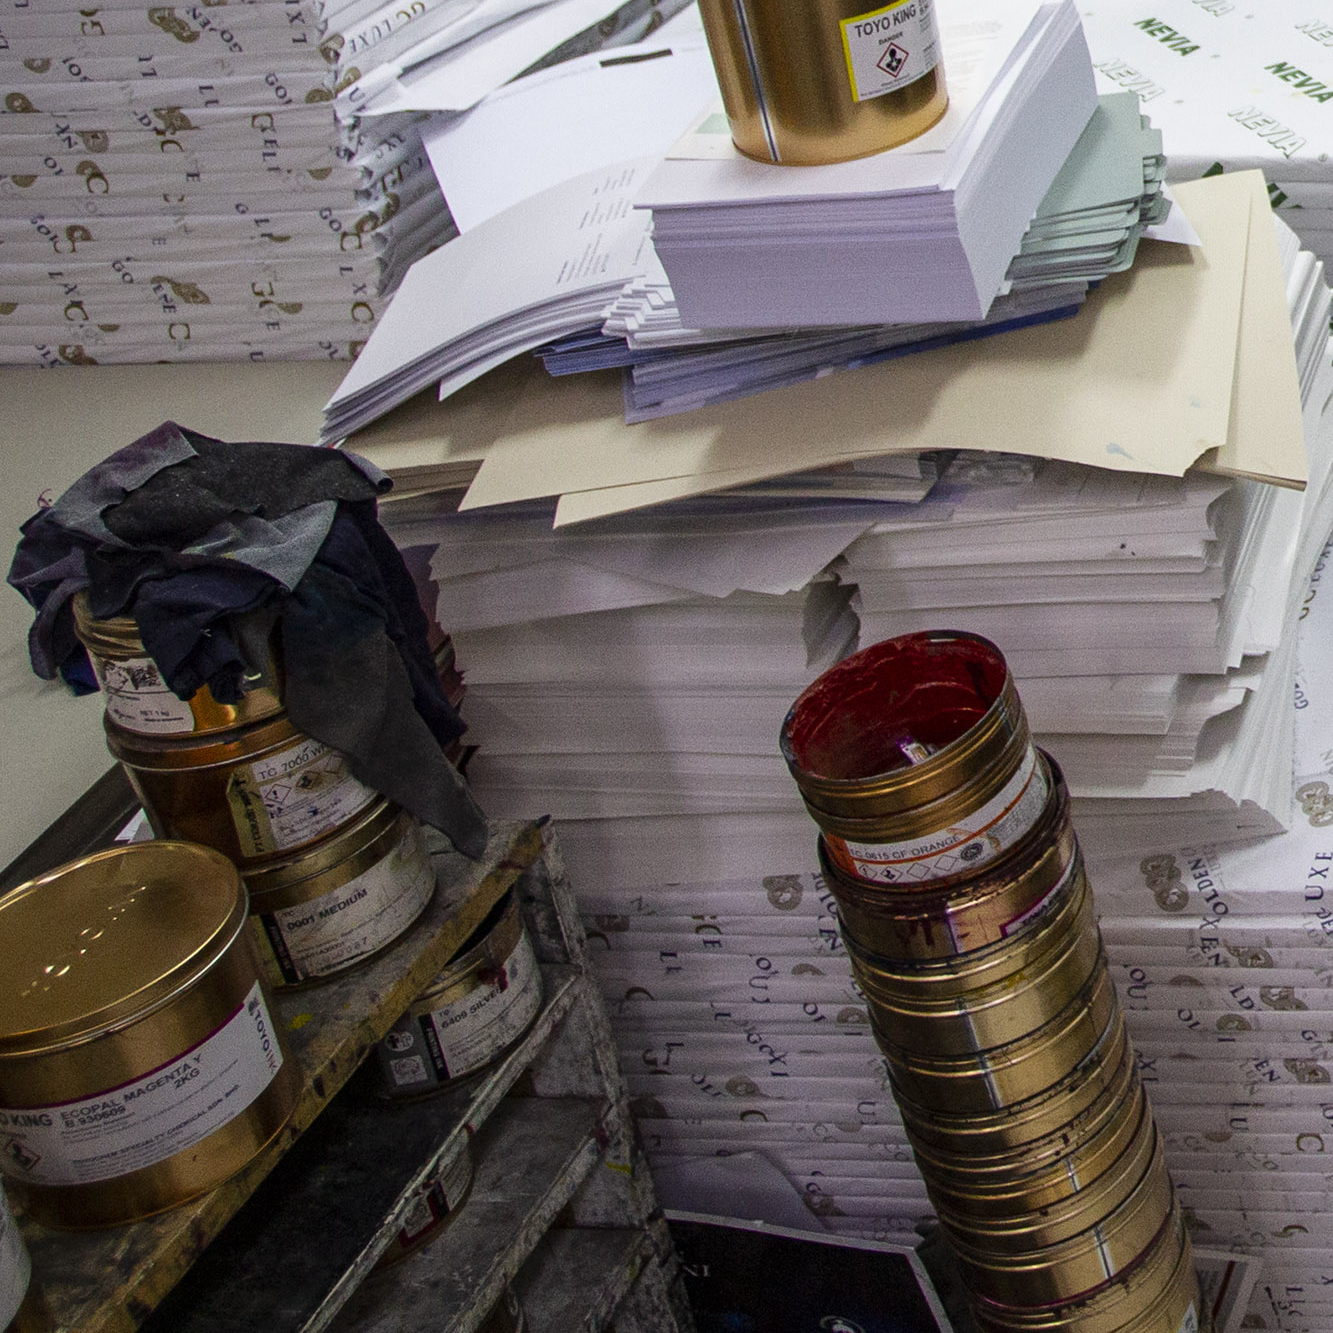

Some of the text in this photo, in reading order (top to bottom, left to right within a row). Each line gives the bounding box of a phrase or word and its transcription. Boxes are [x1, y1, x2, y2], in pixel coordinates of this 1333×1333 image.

[854, 4, 917, 39] TOYO KING
[1133, 17, 1201, 56] NEVIA
[1227, 105, 1308, 159] NEVIA
[910, 835, 960, 857] ORANGE
[318, 887, 368, 919] MEDIUM
[61, 1100, 121, 1120] ECOPAL
[123, 1062, 192, 1103] MAGENTA
[174, 1067, 200, 1090] 2KG
[11, 1113, 53, 1127] KING
